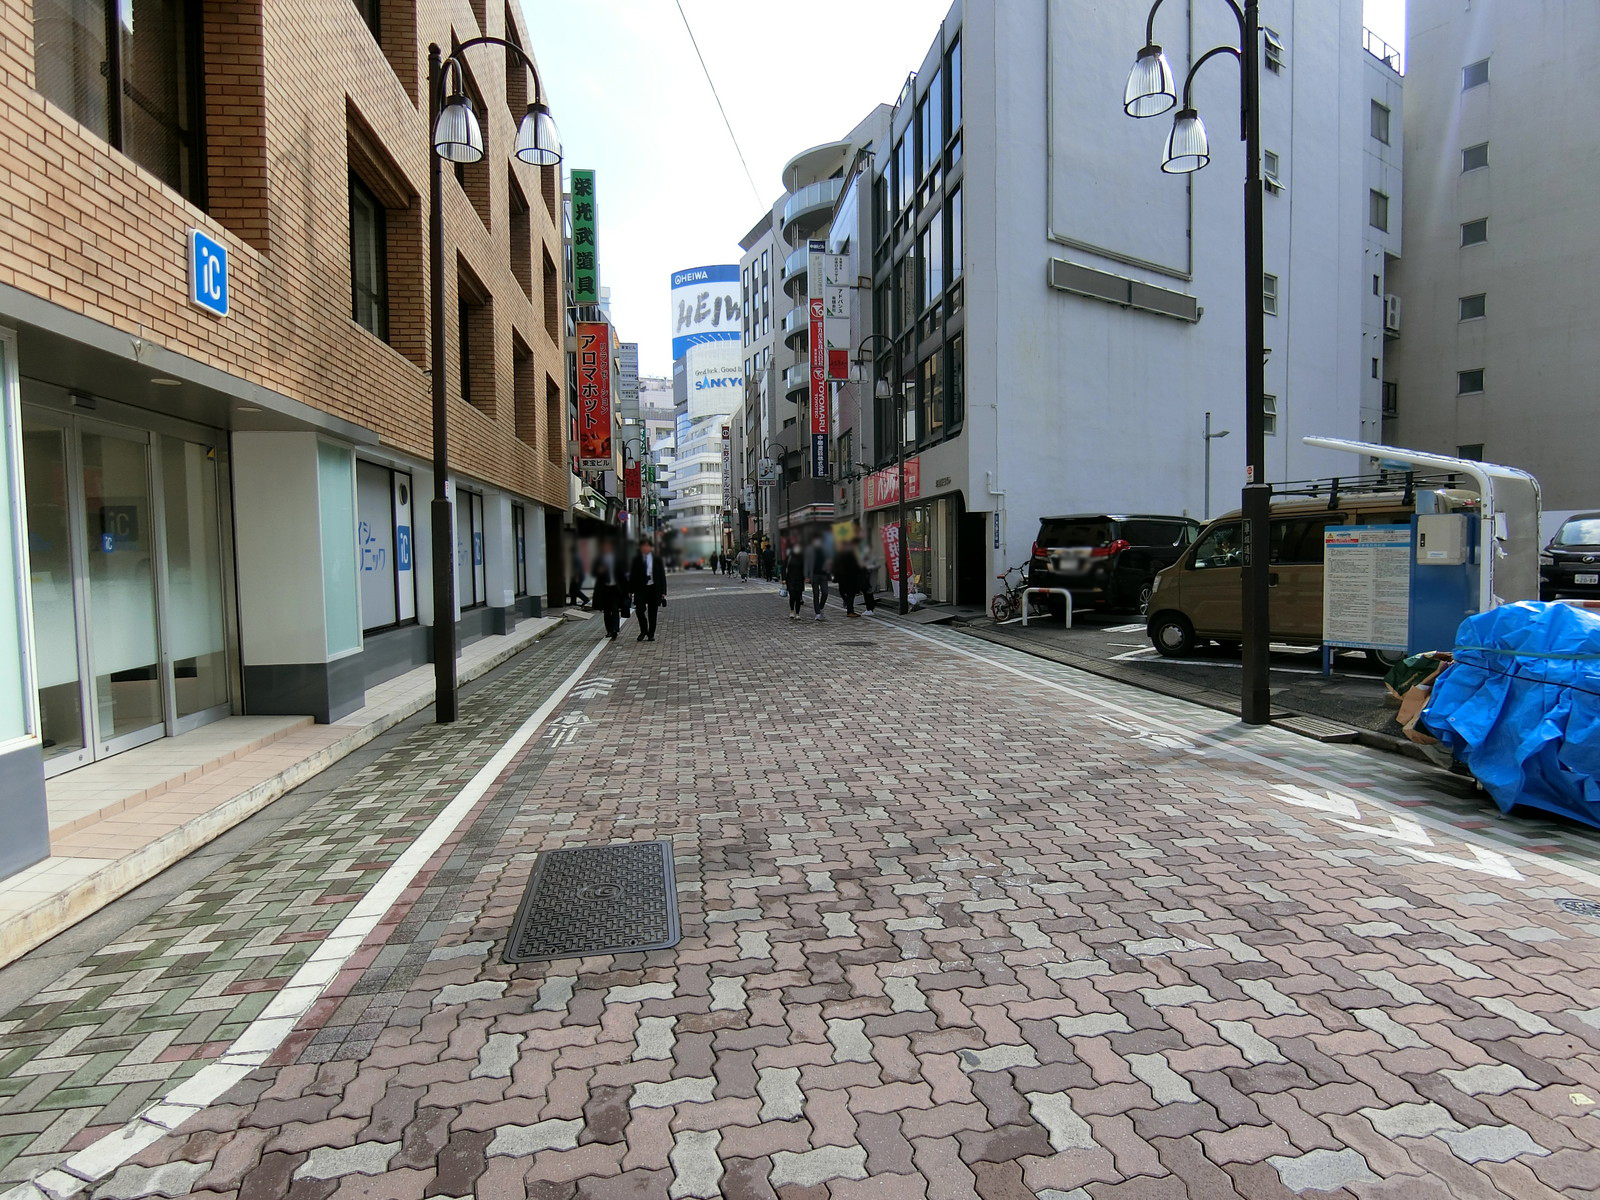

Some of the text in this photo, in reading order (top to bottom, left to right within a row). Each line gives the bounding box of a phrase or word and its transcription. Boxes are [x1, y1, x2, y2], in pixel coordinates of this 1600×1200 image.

[574, 177, 595, 295] 栄光武道具
[681, 270, 708, 282] HEIWA
[580, 334, 598, 430] アロマホット
[599, 343, 609, 415] リラクゼーション
[818, 381, 826, 433] TOYOMARU
